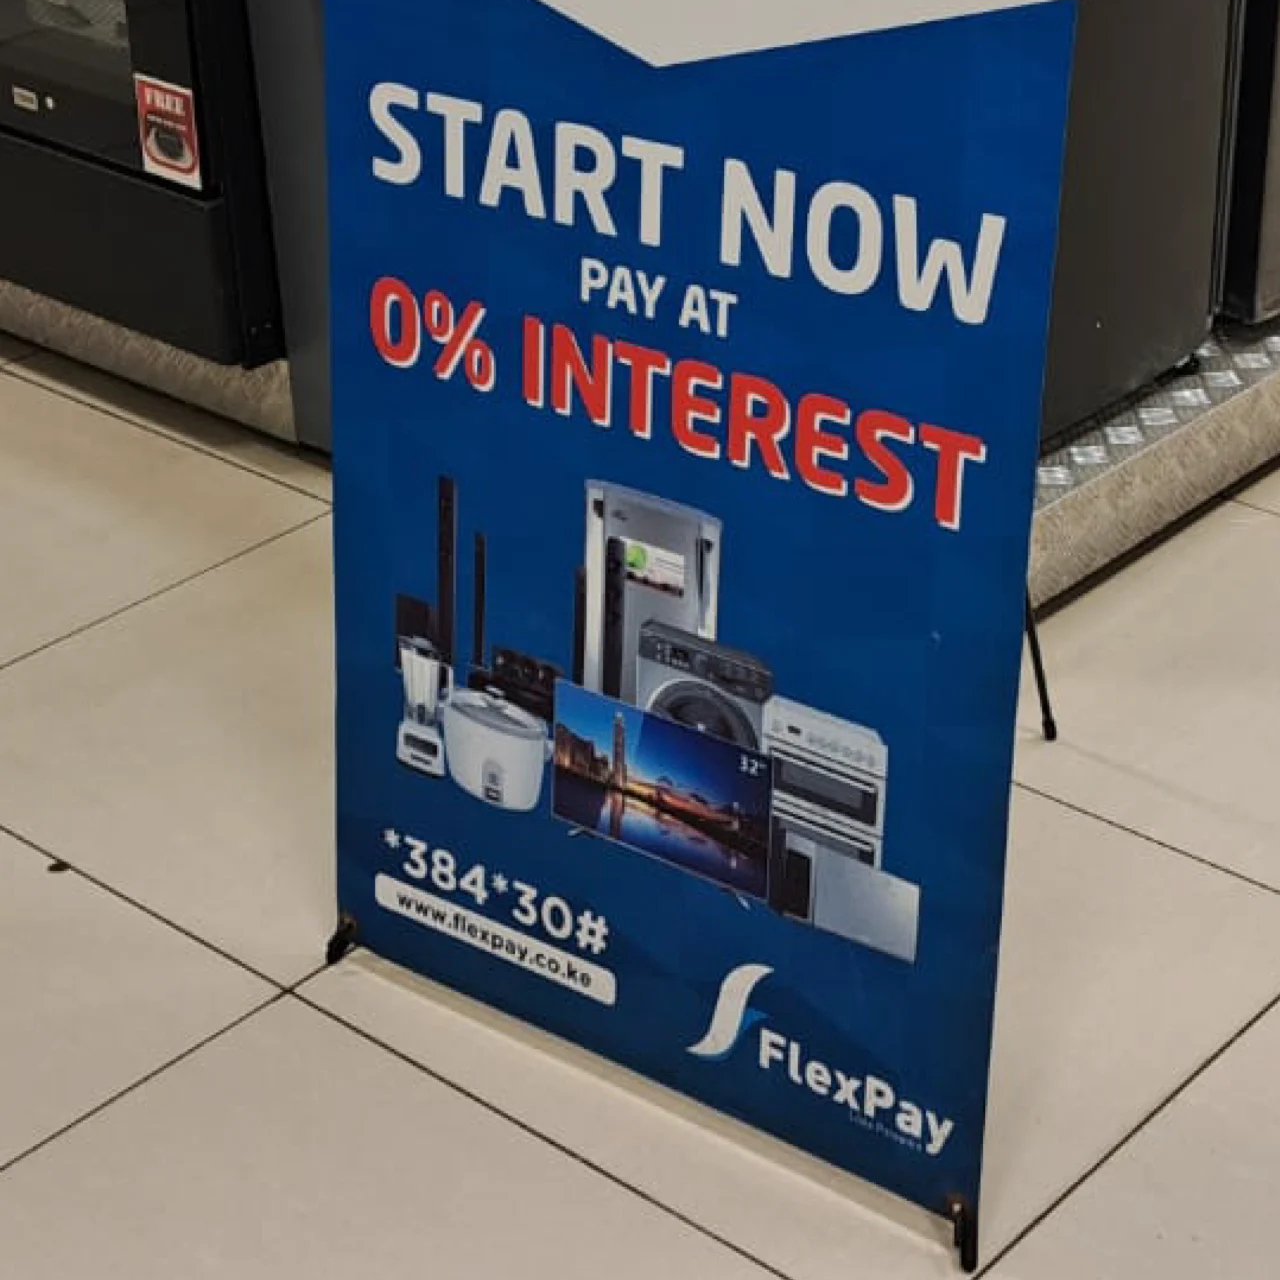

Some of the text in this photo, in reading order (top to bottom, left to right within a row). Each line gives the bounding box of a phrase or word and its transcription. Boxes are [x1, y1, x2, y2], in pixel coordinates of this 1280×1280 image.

[369, 82, 1006, 325] START NOW
[580, 257, 738, 338] PAY AT
[369, 276, 987, 531] 0% INTEREST
[397, 892, 592, 988] www.flexpay.co.ke
[759, 1027, 954, 1155] FlexPay
